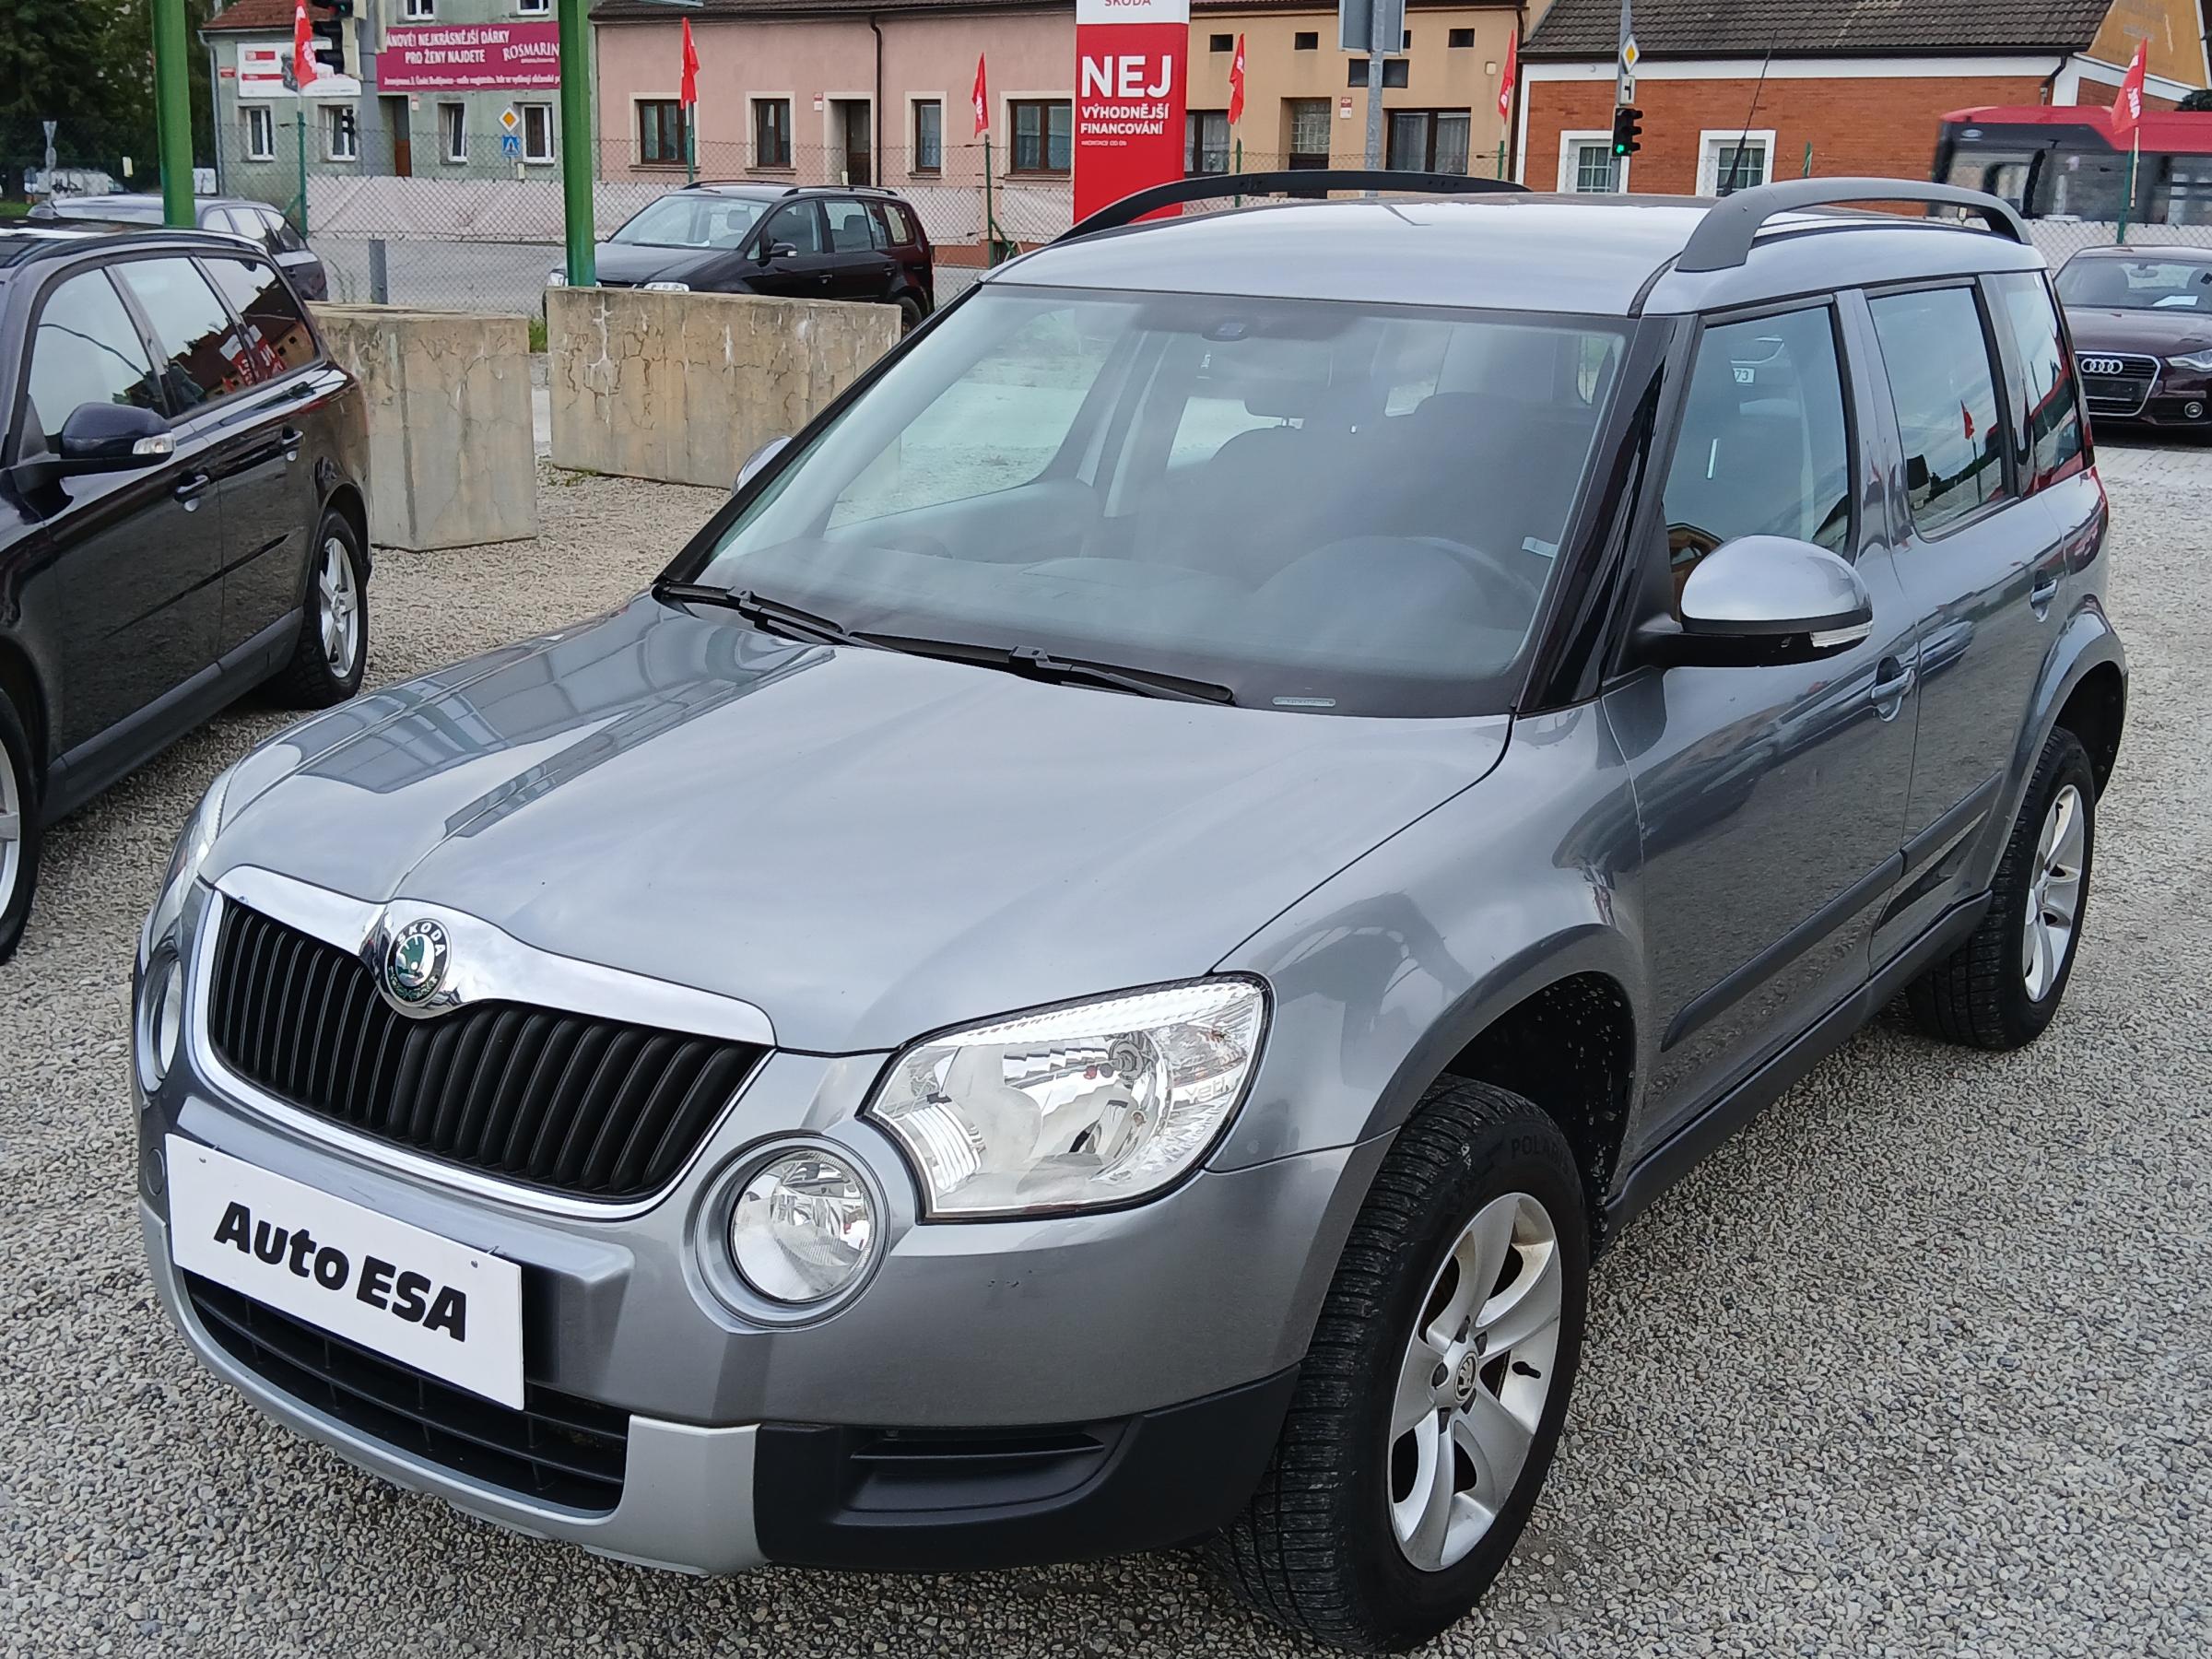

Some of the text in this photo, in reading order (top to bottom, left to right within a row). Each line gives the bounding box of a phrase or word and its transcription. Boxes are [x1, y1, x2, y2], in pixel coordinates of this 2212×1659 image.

[418, 28, 479, 46] NEJKRÁSNĚJŠÍ
[481, 28, 510, 45] DÁRKY
[405, 48, 486, 65] PRO ŽENY NAJDETE
[1081, 54, 1172, 99] NEJ
[1081, 103, 1170, 120] VÝHODNĚJŠÍ
[1080, 121, 1164, 135] FINANCOVÁNÍ
[213, 1201, 467, 1343] Auto ESA
